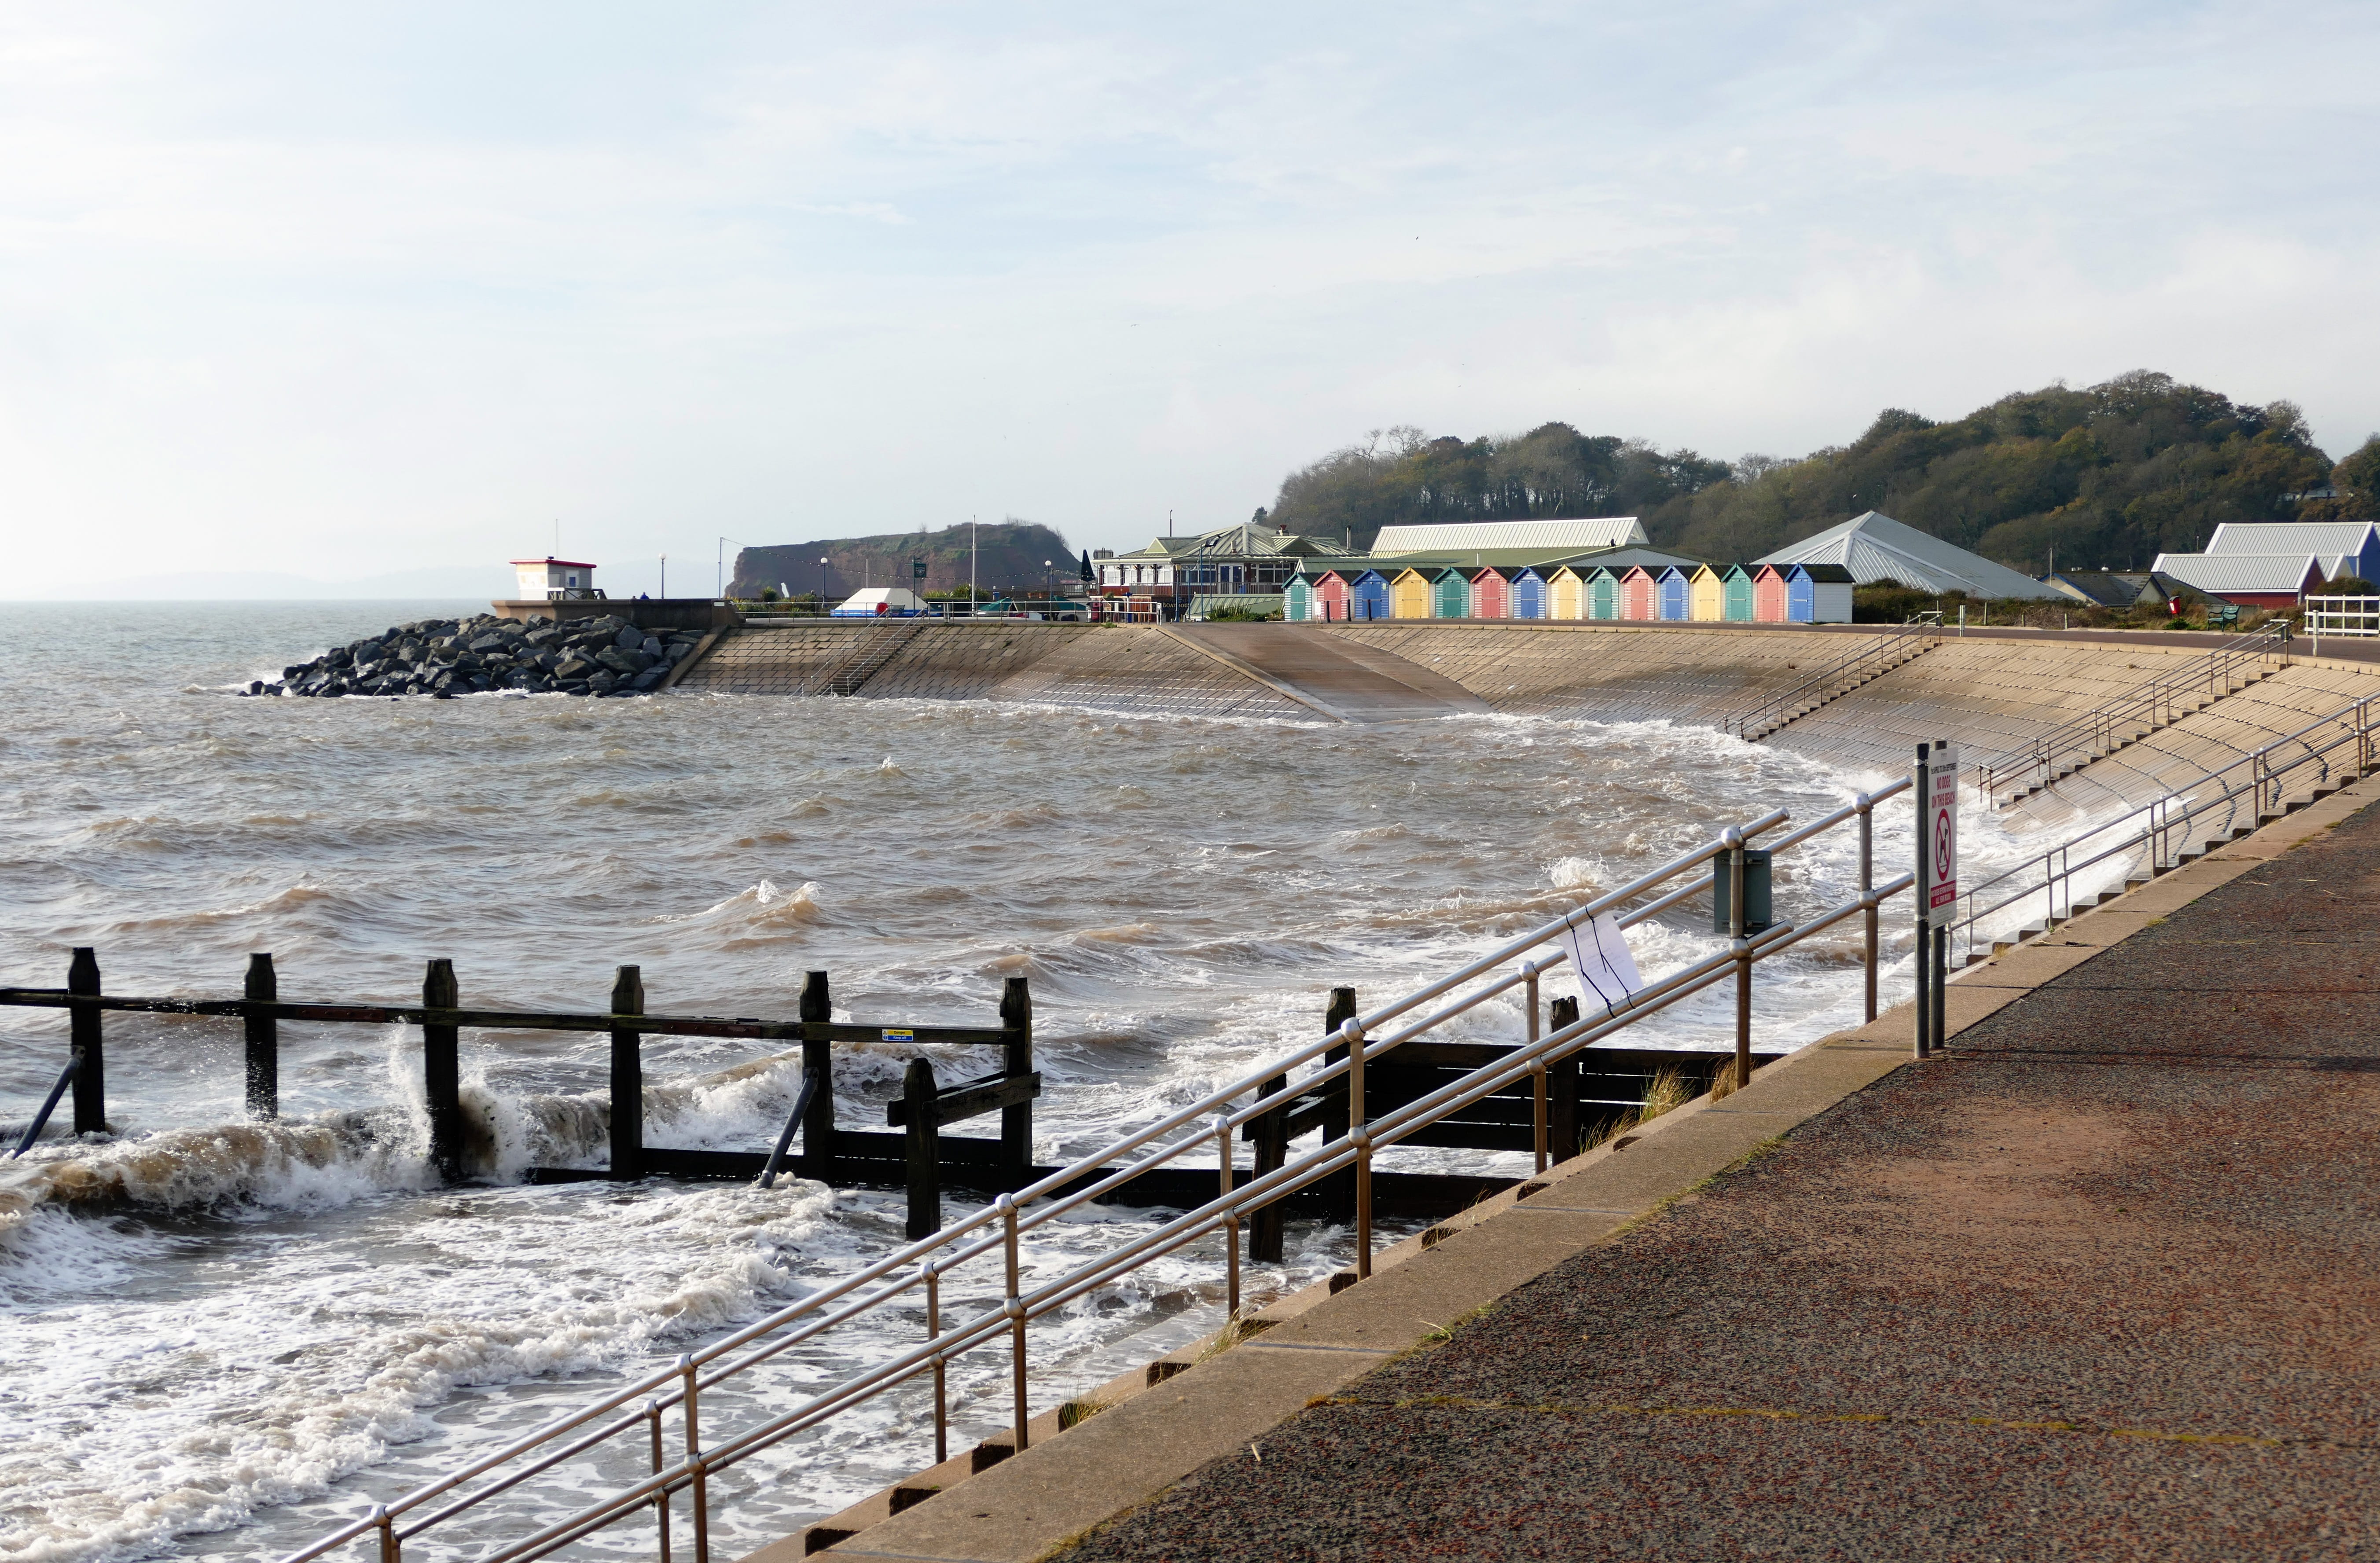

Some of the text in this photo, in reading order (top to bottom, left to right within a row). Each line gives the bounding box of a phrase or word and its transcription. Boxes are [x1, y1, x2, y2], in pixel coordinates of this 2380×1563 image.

[1946, 762, 1957, 771] SEPTEMBER
[1937, 774, 1950, 790] NO DOGS
[1932, 795, 1937, 809] ON
[1945, 791, 1955, 806] BEACH
